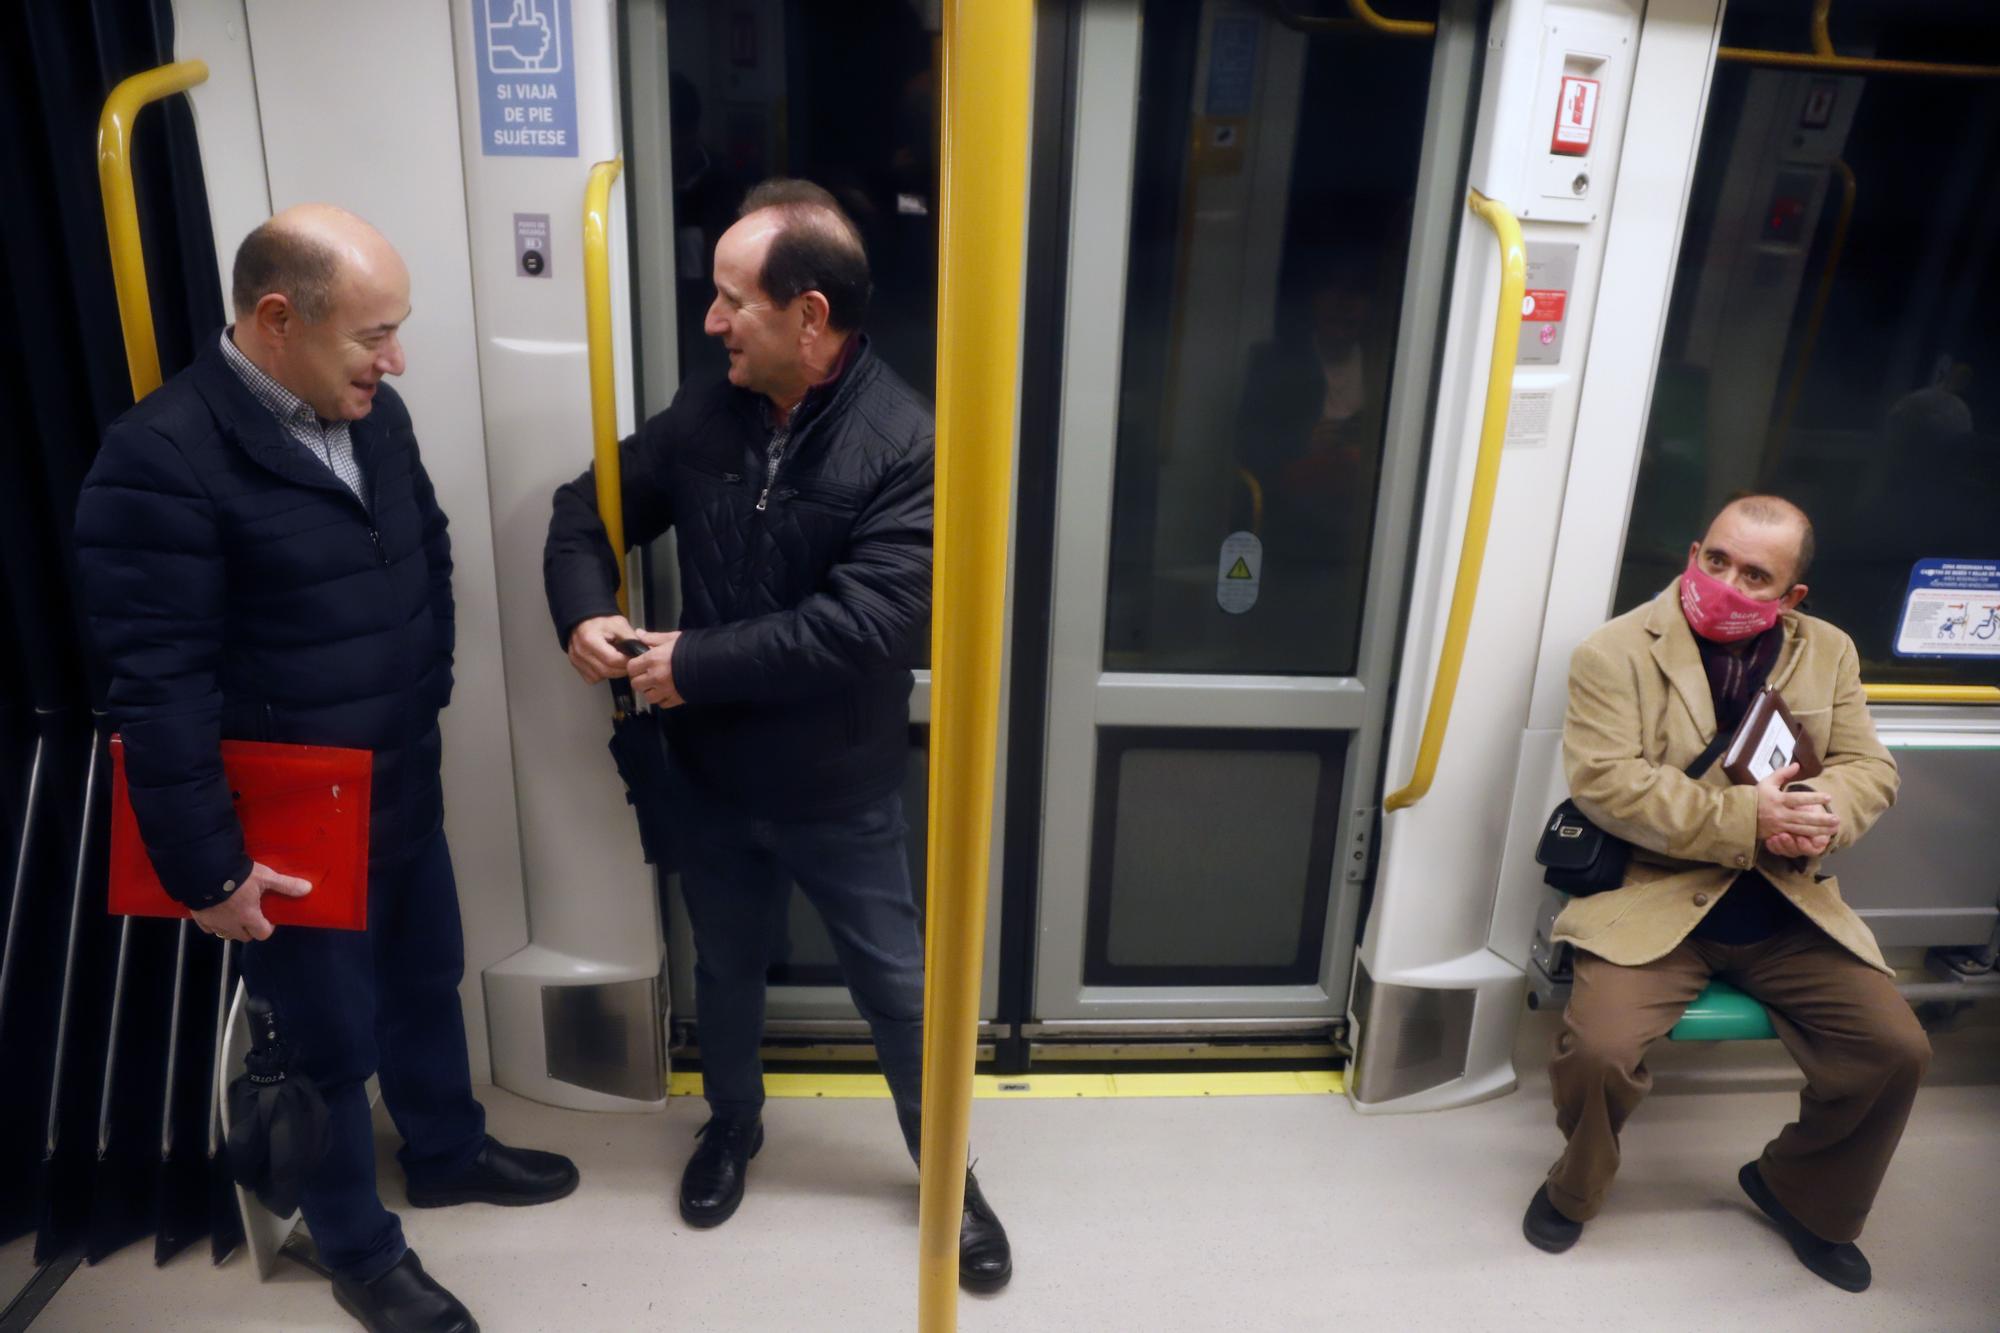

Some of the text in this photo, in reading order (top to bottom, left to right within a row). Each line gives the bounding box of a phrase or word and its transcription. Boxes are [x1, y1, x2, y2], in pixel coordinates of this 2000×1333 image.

[496, 83, 558, 100] SI VIAJA
[504, 106, 553, 123] DE PIE
[493, 125, 567, 146] SUJÉTESE
